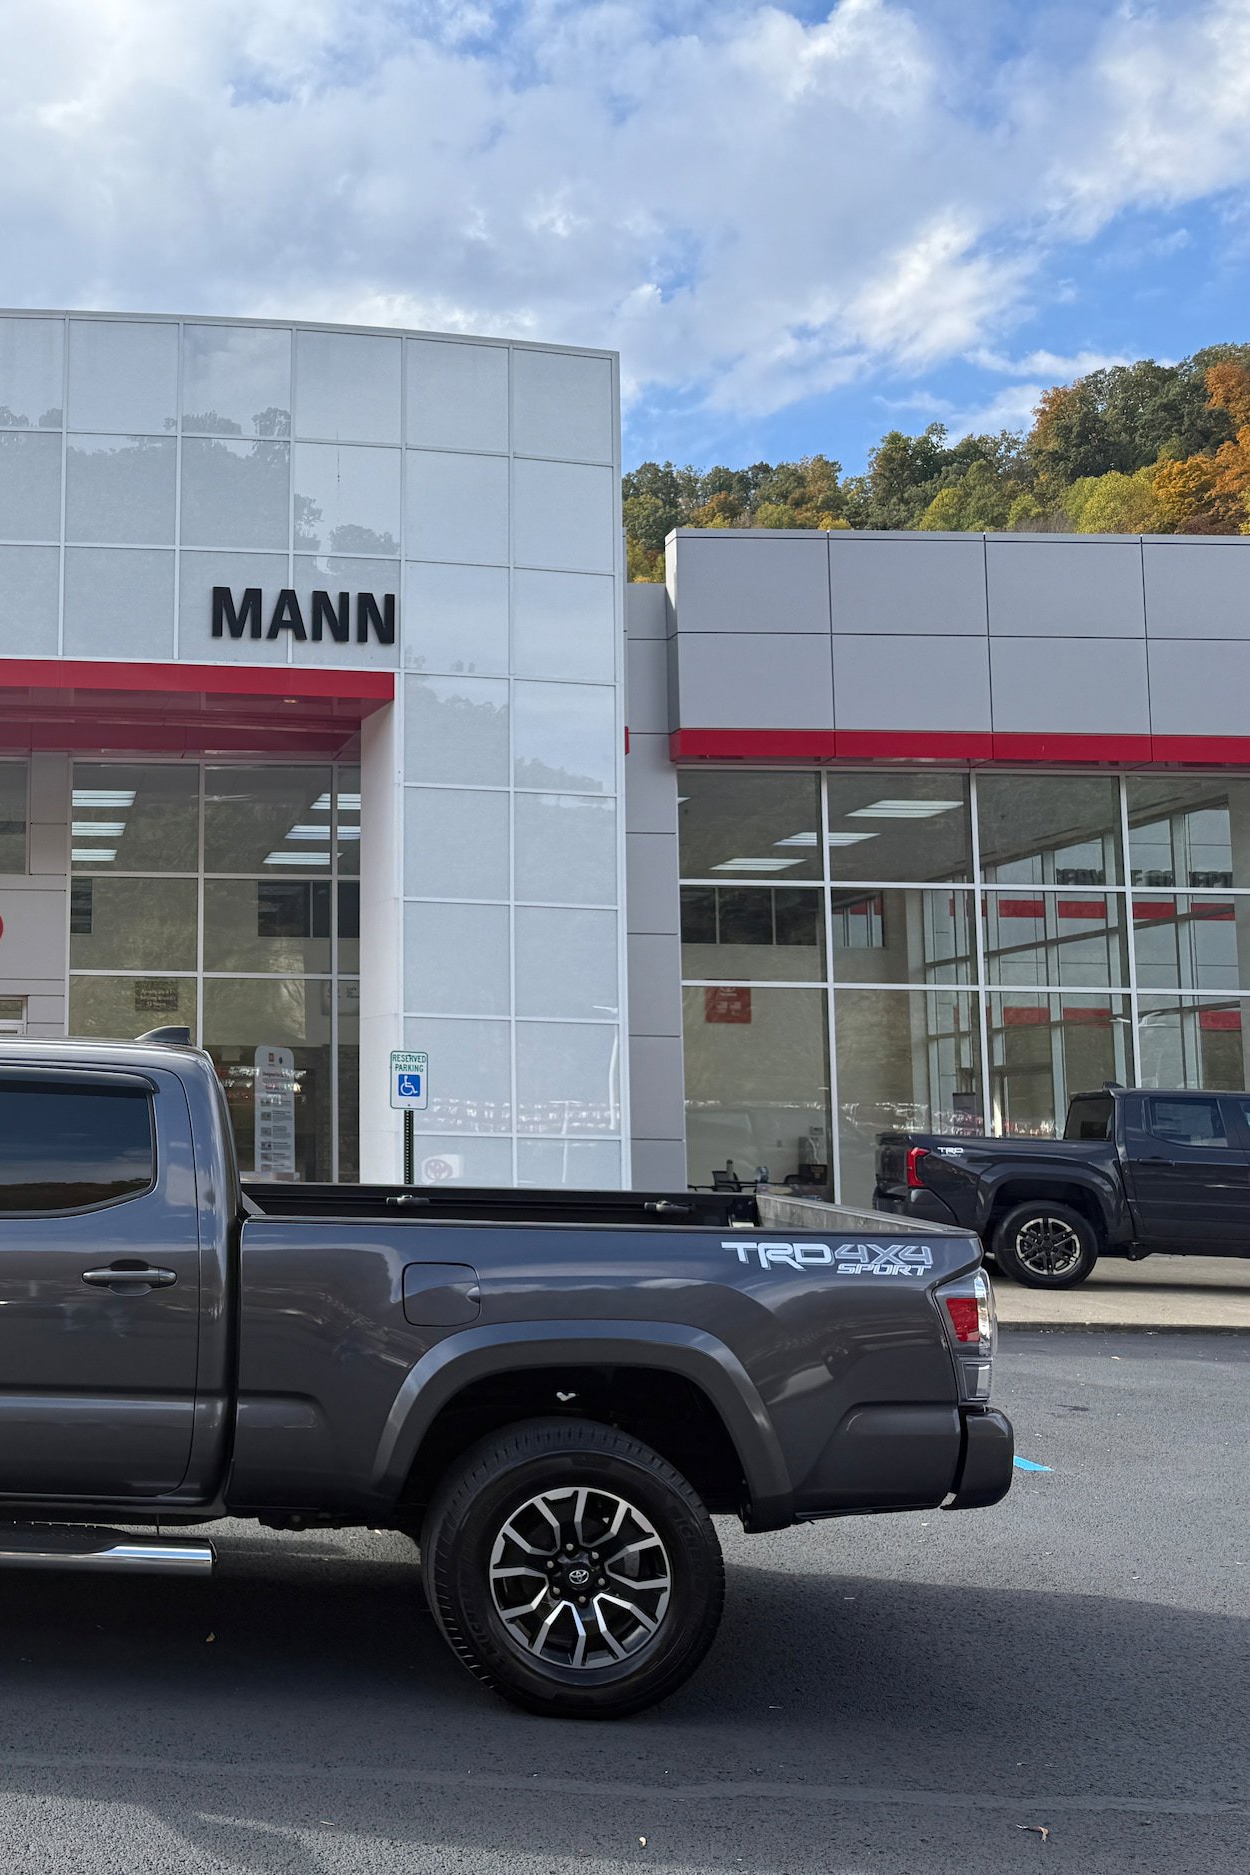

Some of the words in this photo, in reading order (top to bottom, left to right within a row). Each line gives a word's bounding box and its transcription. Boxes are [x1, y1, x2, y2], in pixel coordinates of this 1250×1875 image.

[212, 586, 395, 644] MANN
[392, 1054, 427, 1063] RESERVED
[395, 1064, 424, 1072] PARKING
[721, 1242, 836, 1271] TRD
[836, 1264, 932, 1276] SPORT
